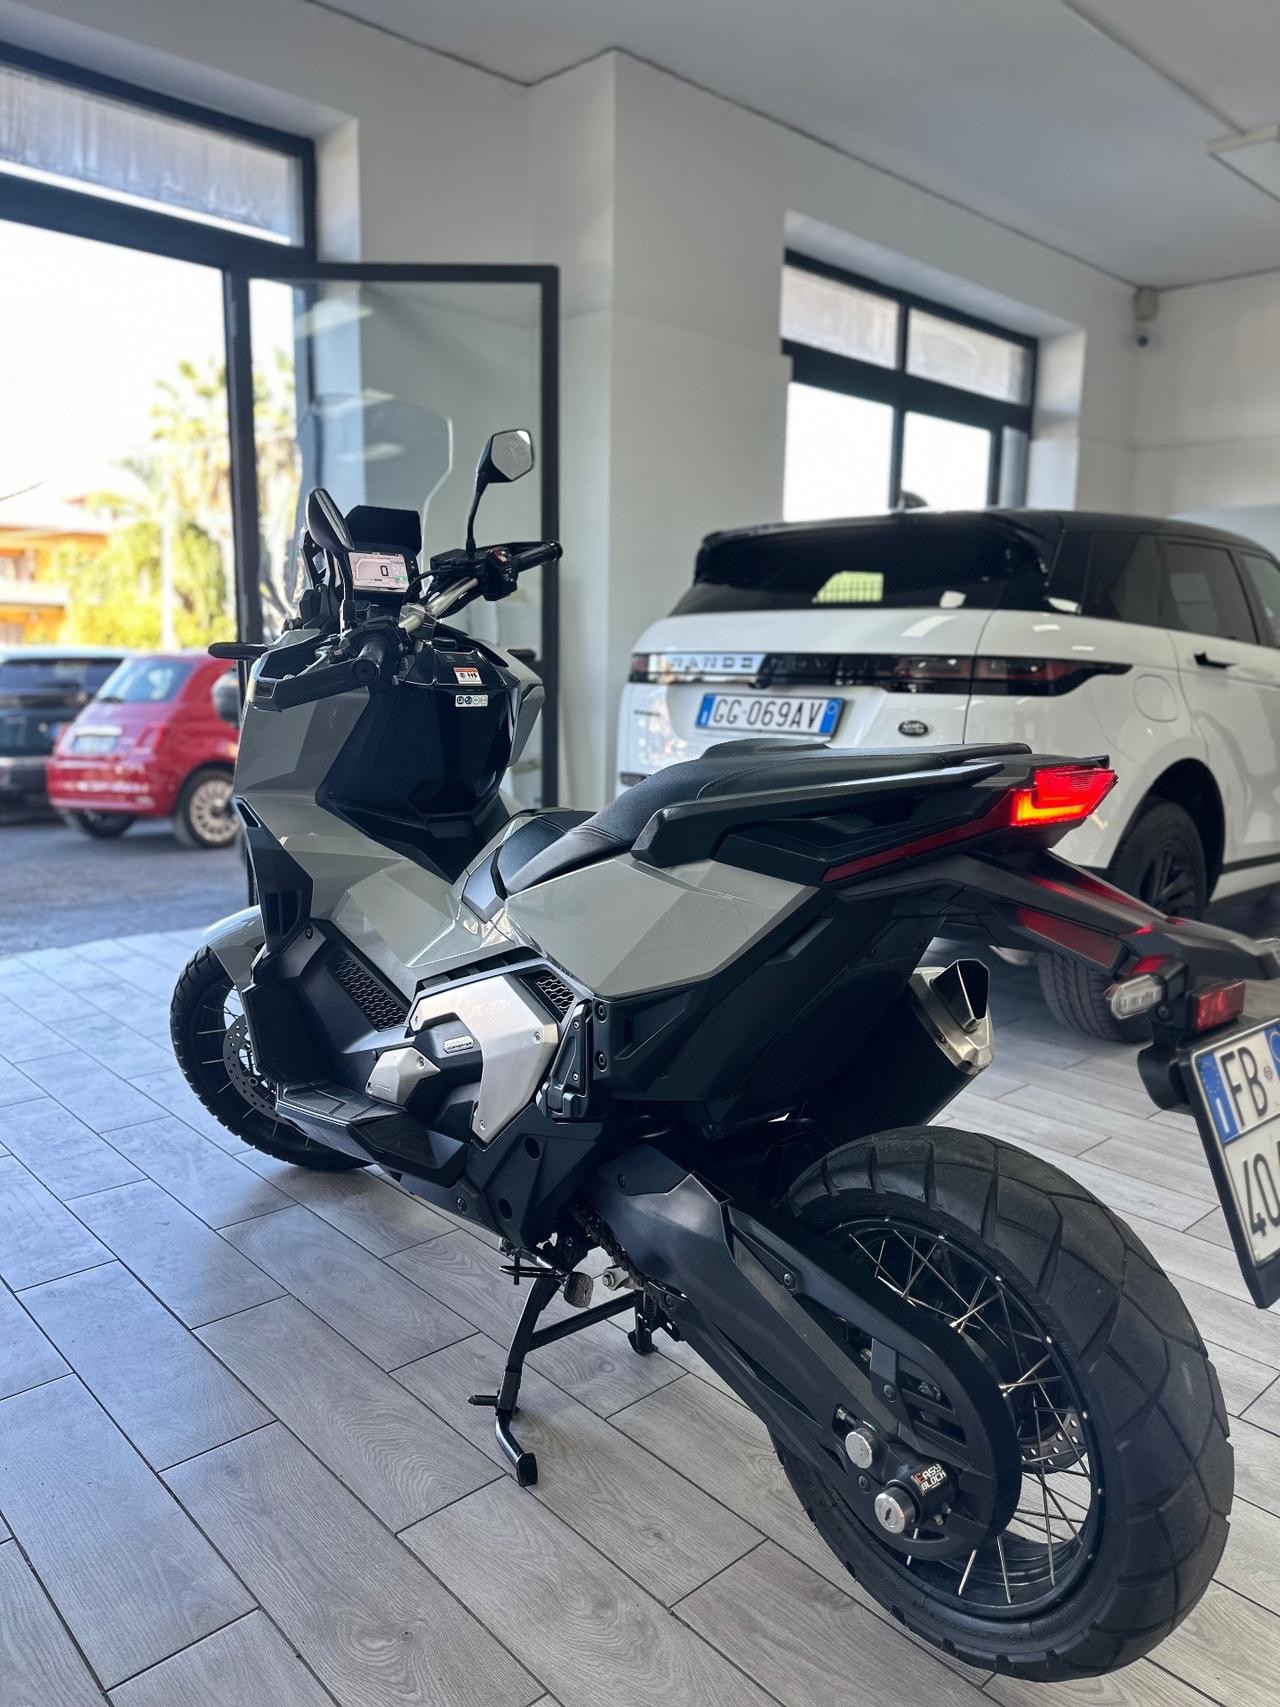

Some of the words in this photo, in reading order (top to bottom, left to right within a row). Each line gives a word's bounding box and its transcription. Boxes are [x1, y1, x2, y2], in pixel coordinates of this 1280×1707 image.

[380, 565, 389, 577] 0
[1219, 1046, 1269, 1128] FB
[1242, 1140, 1280, 1238] 40
[913, 1463, 943, 1484] EASY
